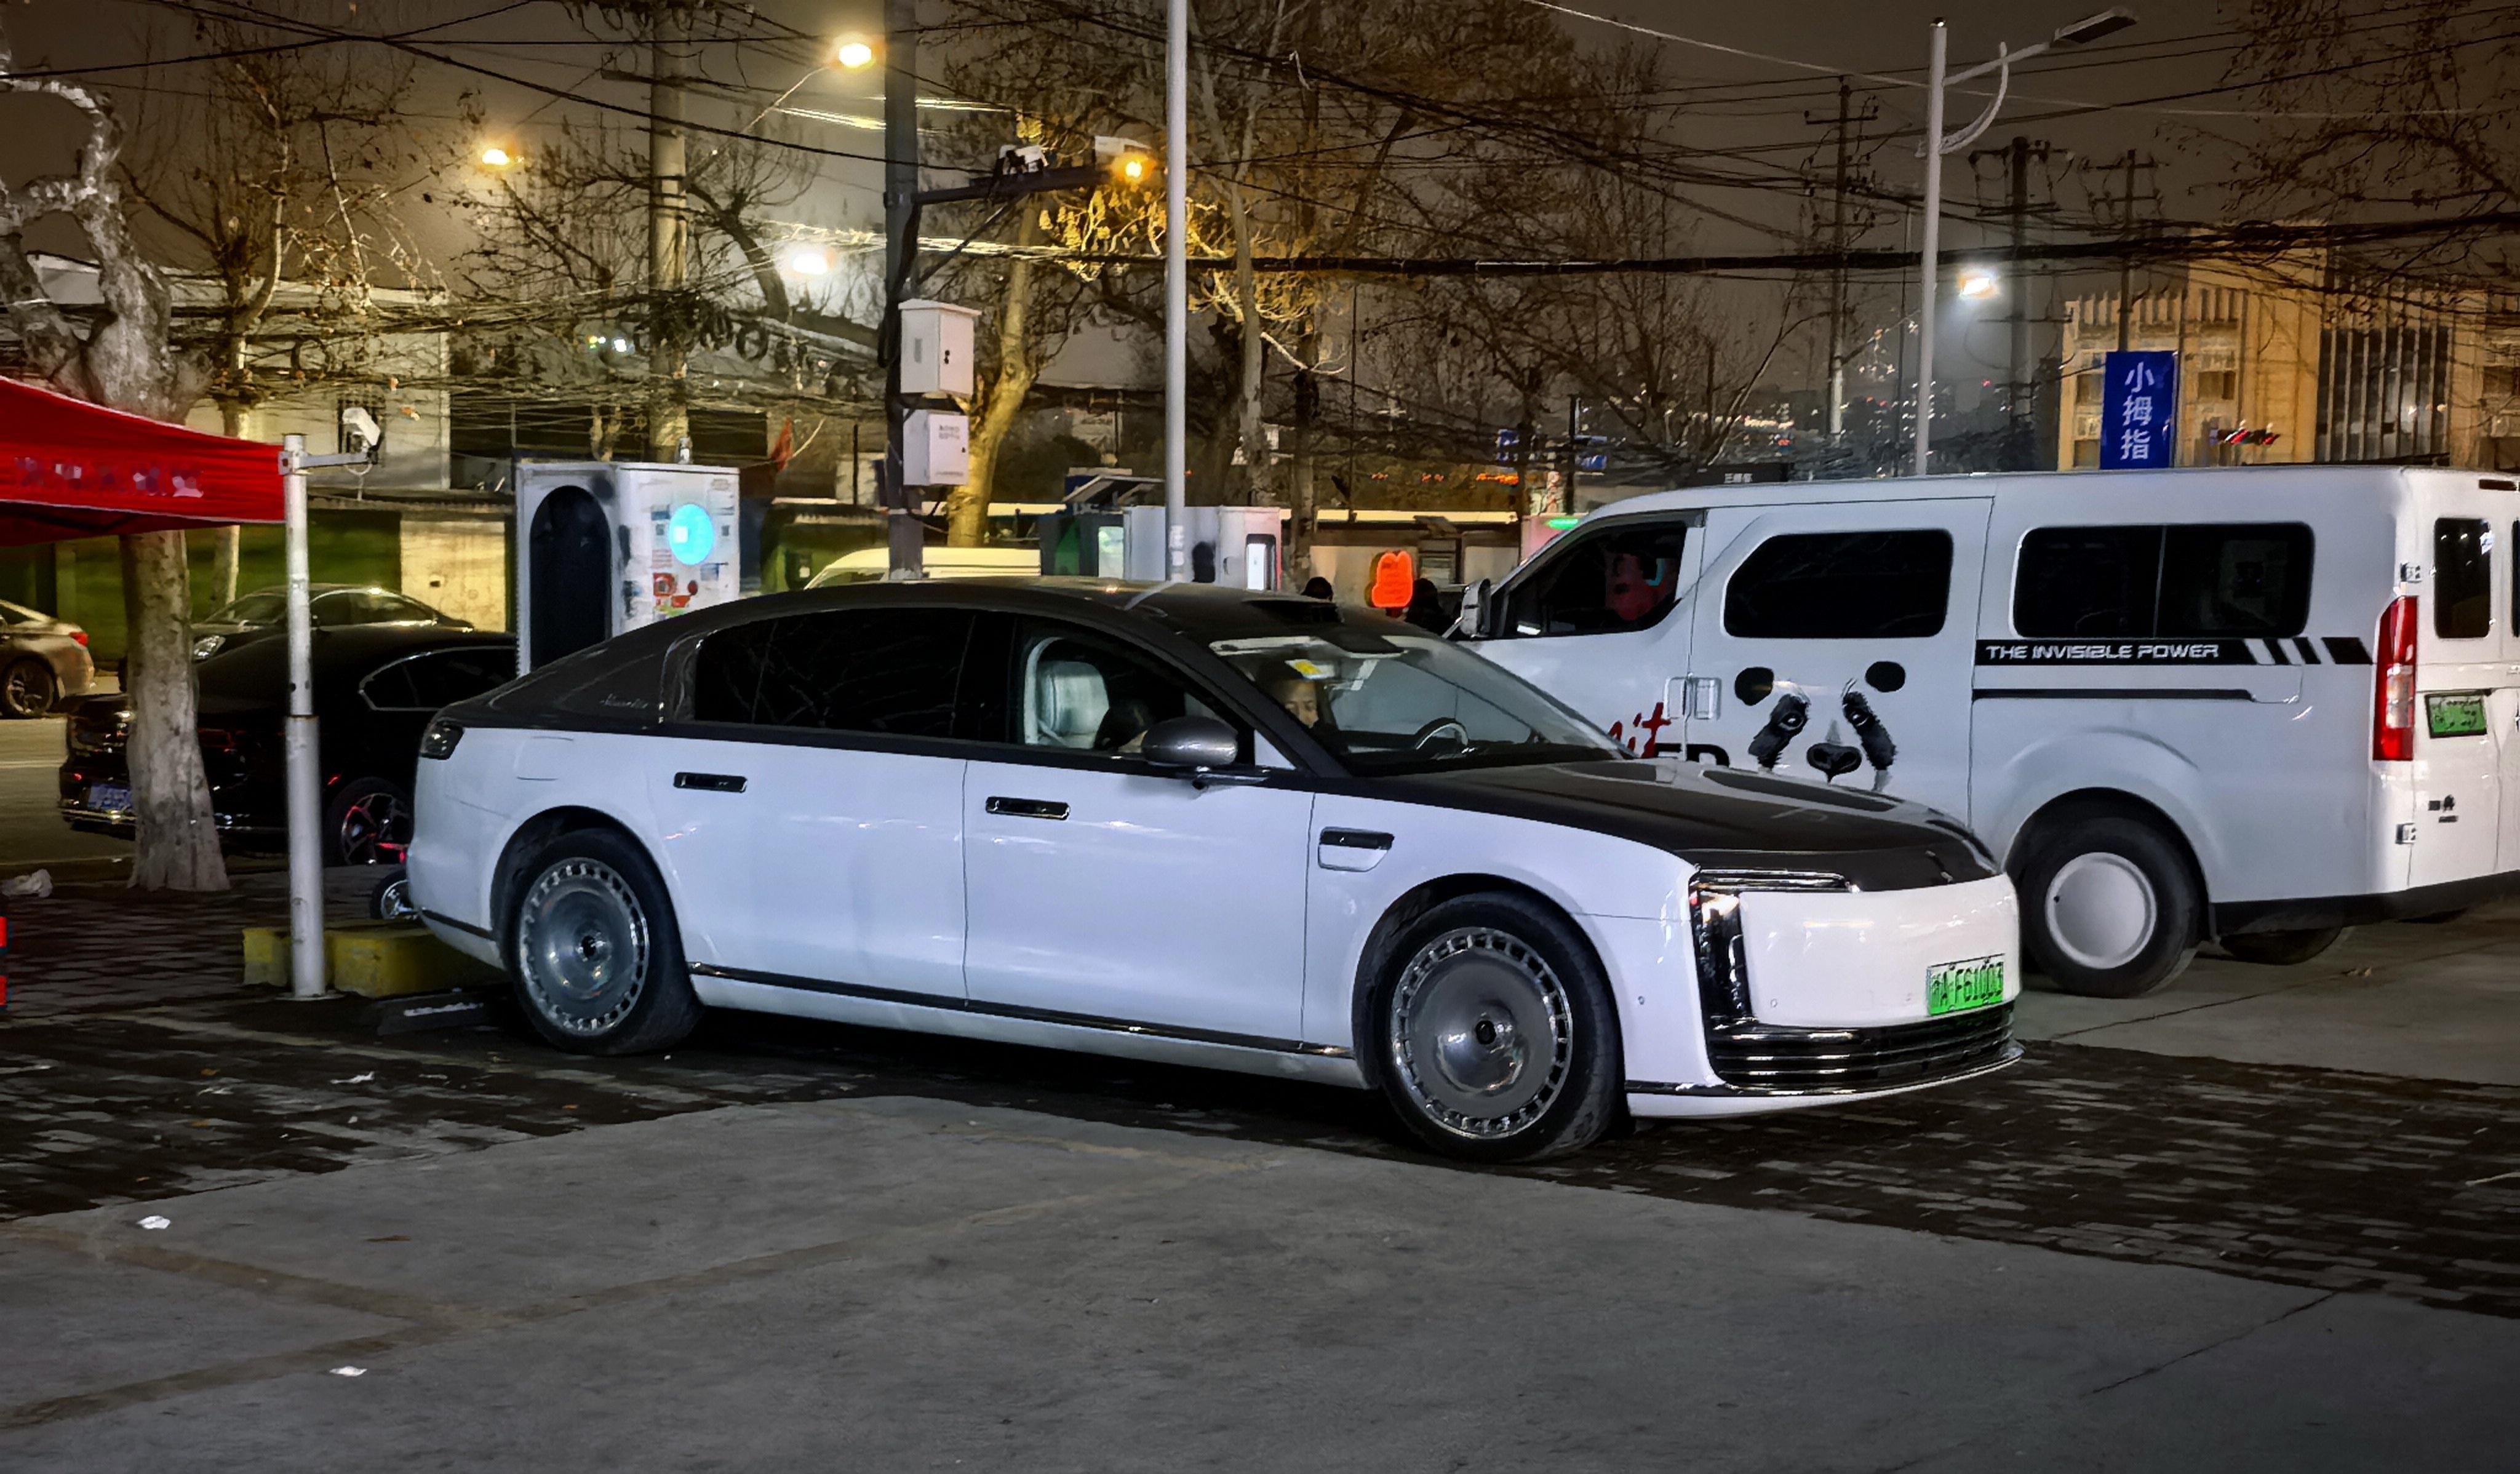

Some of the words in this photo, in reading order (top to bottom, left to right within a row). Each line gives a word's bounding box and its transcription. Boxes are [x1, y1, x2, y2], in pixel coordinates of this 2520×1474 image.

[2120, 361, 2155, 461] 小拇指
[1985, 645, 2028, 660] THE
[2032, 645, 2133, 659] INVISIBLE
[2137, 644, 2219, 659] POWER
